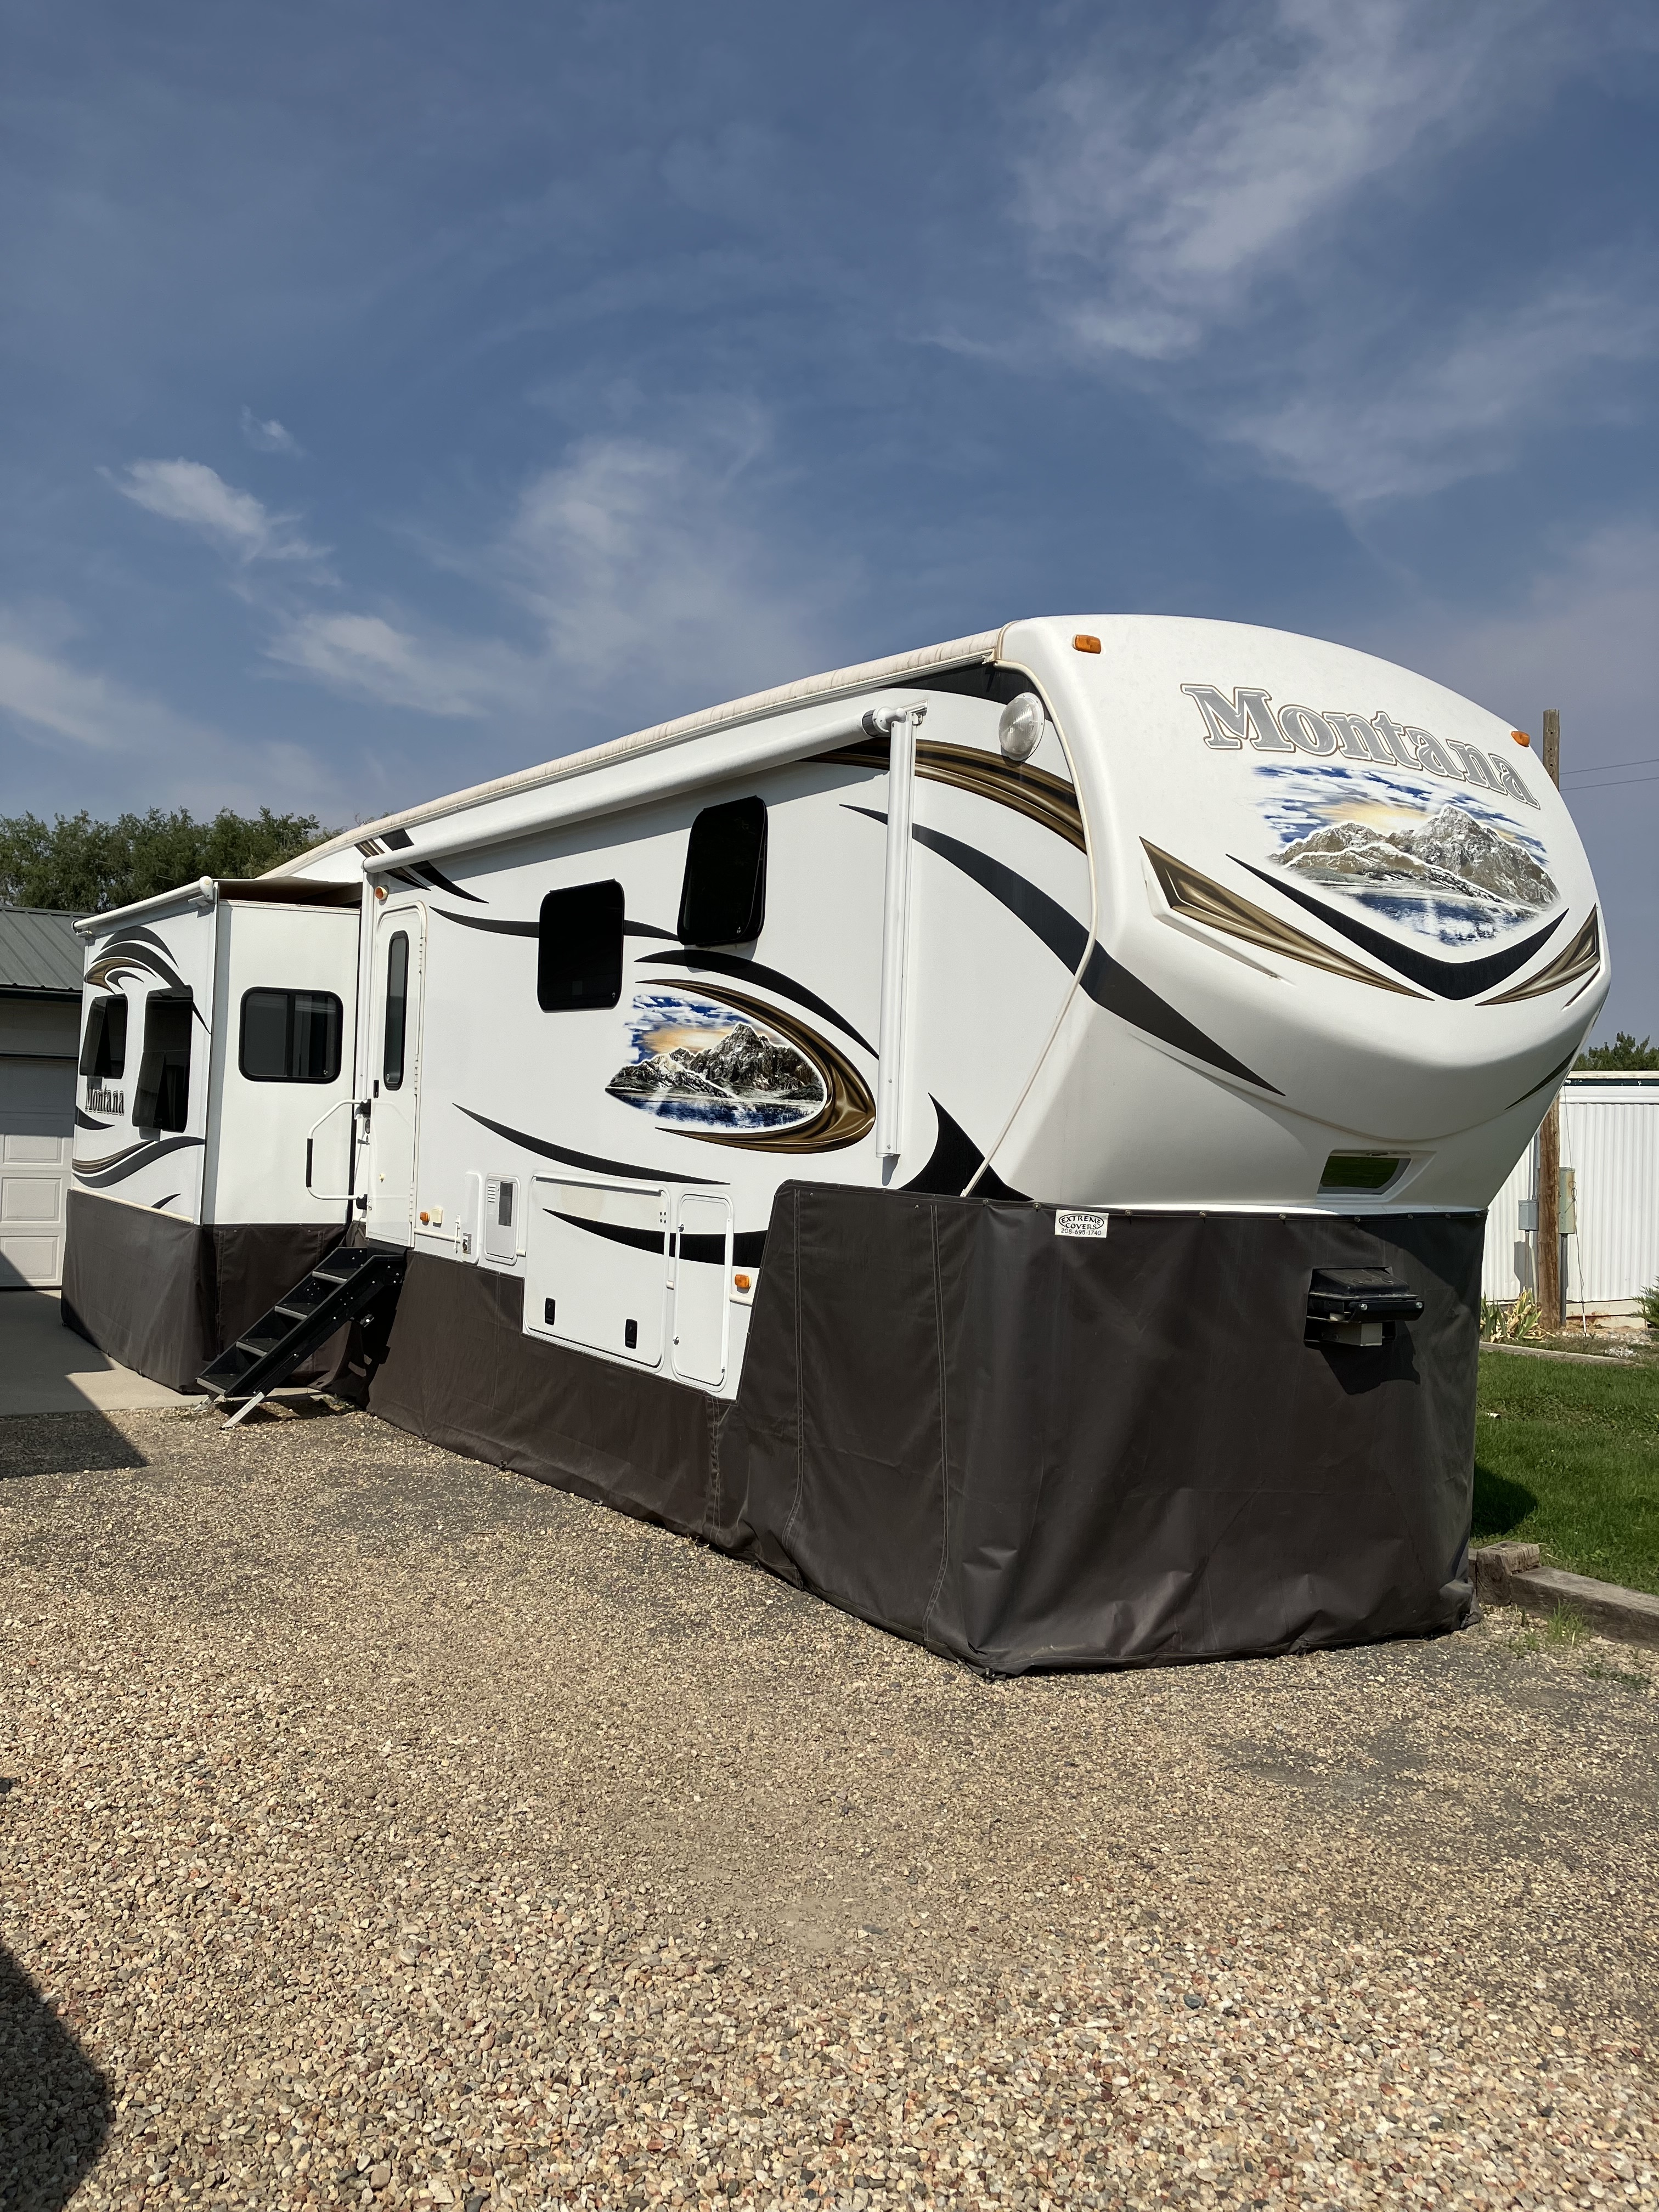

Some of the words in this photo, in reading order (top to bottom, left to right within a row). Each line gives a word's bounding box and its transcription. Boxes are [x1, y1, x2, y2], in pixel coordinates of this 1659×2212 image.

[1180, 683, 1541, 809] Montana
[85, 1084, 125, 1116] Montana
[1061, 1215, 1101, 1226] EXTREME
